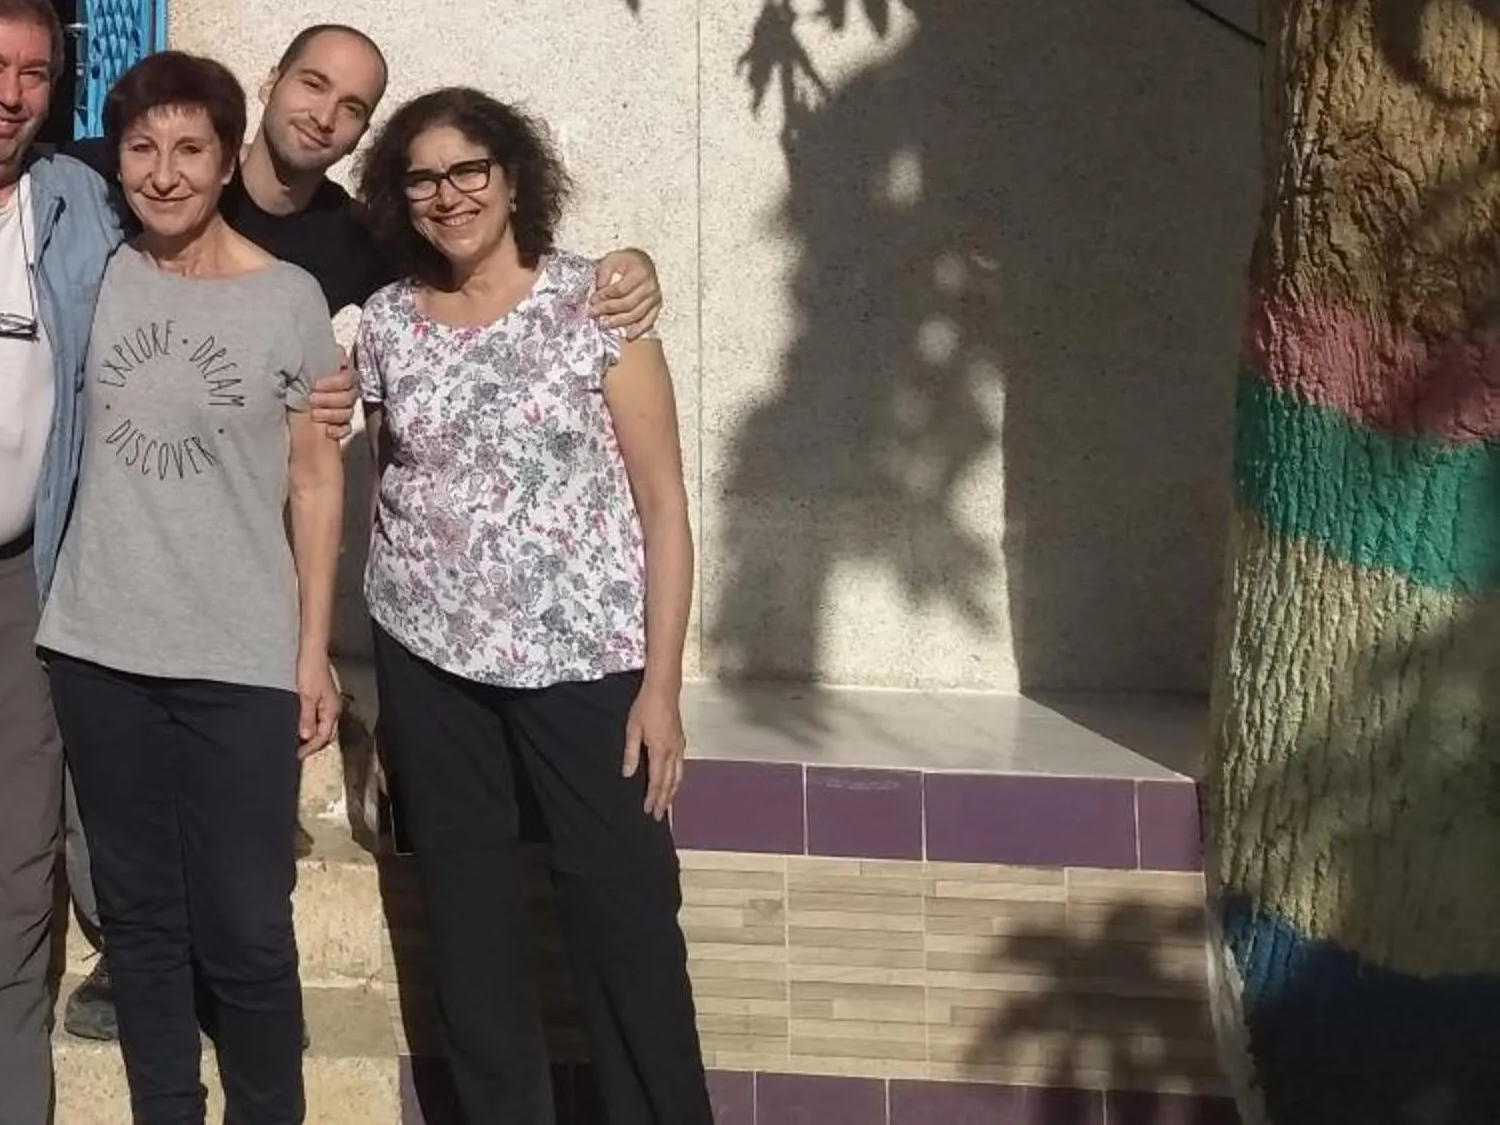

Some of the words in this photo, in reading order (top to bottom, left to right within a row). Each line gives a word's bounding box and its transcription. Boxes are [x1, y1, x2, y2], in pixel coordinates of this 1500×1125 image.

[98, 320, 175, 388] EXPLORE
[189, 335, 245, 407] DREAM
[105, 419, 216, 480] DISCOVER
